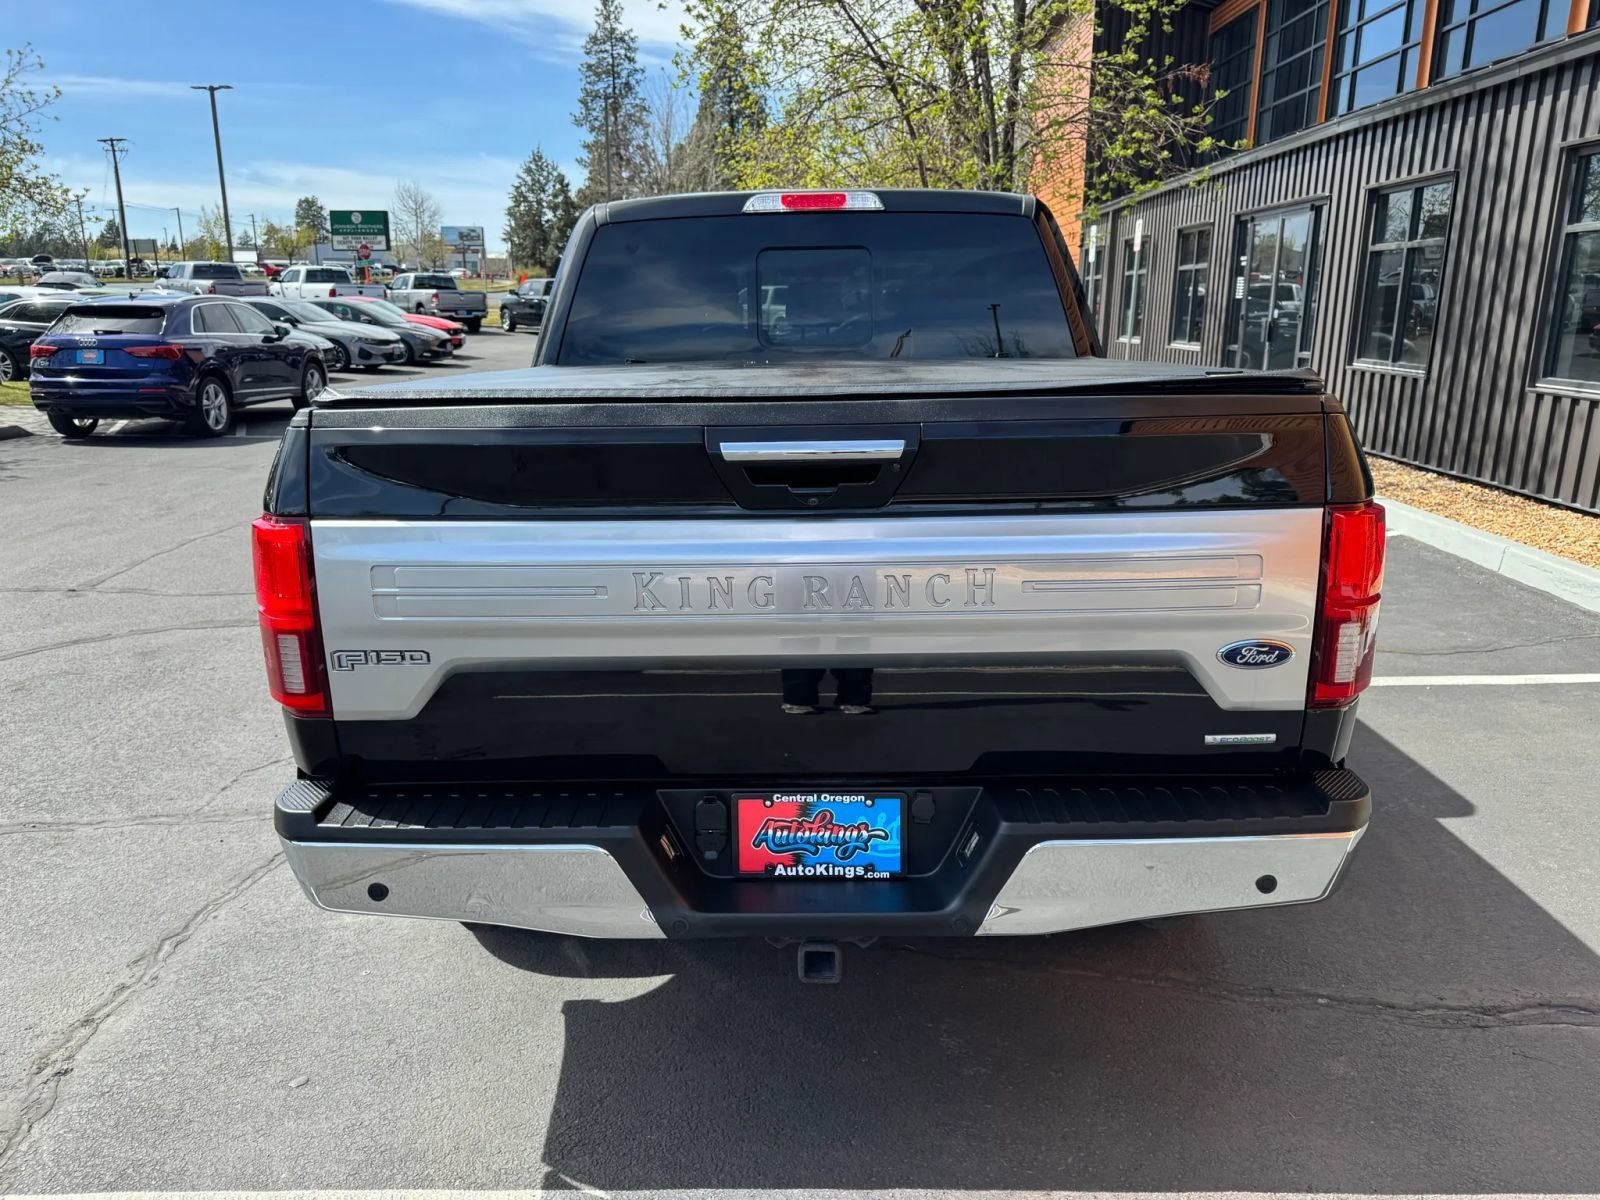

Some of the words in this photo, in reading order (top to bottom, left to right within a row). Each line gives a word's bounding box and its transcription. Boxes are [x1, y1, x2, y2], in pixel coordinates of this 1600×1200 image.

[631, 572, 776, 612] KING
[801, 567, 997, 610] RANCH
[1236, 646, 1279, 664] Ford
[772, 793, 818, 803] Central
[820, 793, 865, 804] Oregon
